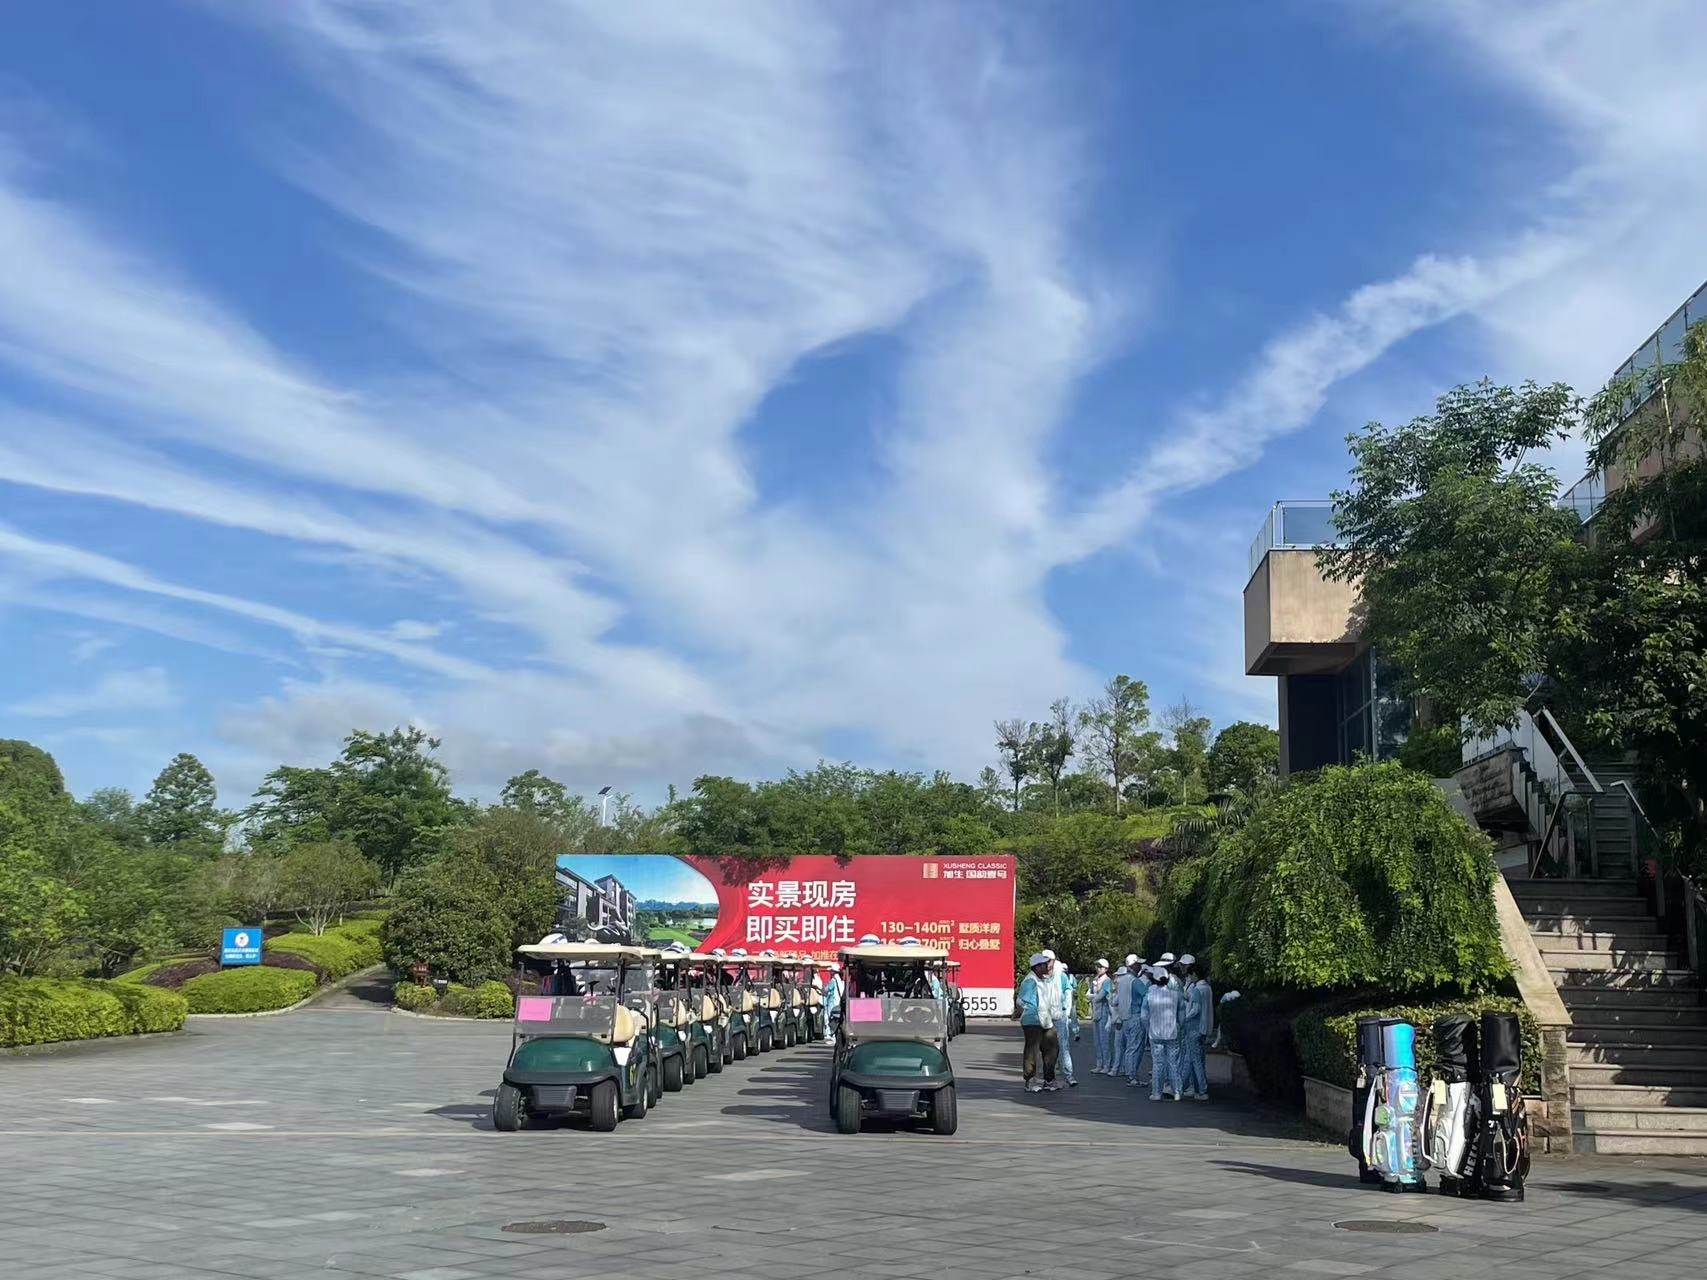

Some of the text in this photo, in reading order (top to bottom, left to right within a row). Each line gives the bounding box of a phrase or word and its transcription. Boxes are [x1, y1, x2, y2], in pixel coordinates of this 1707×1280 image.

[747, 880, 857, 908] 实景现房
[746, 915, 856, 944] 即买即住
